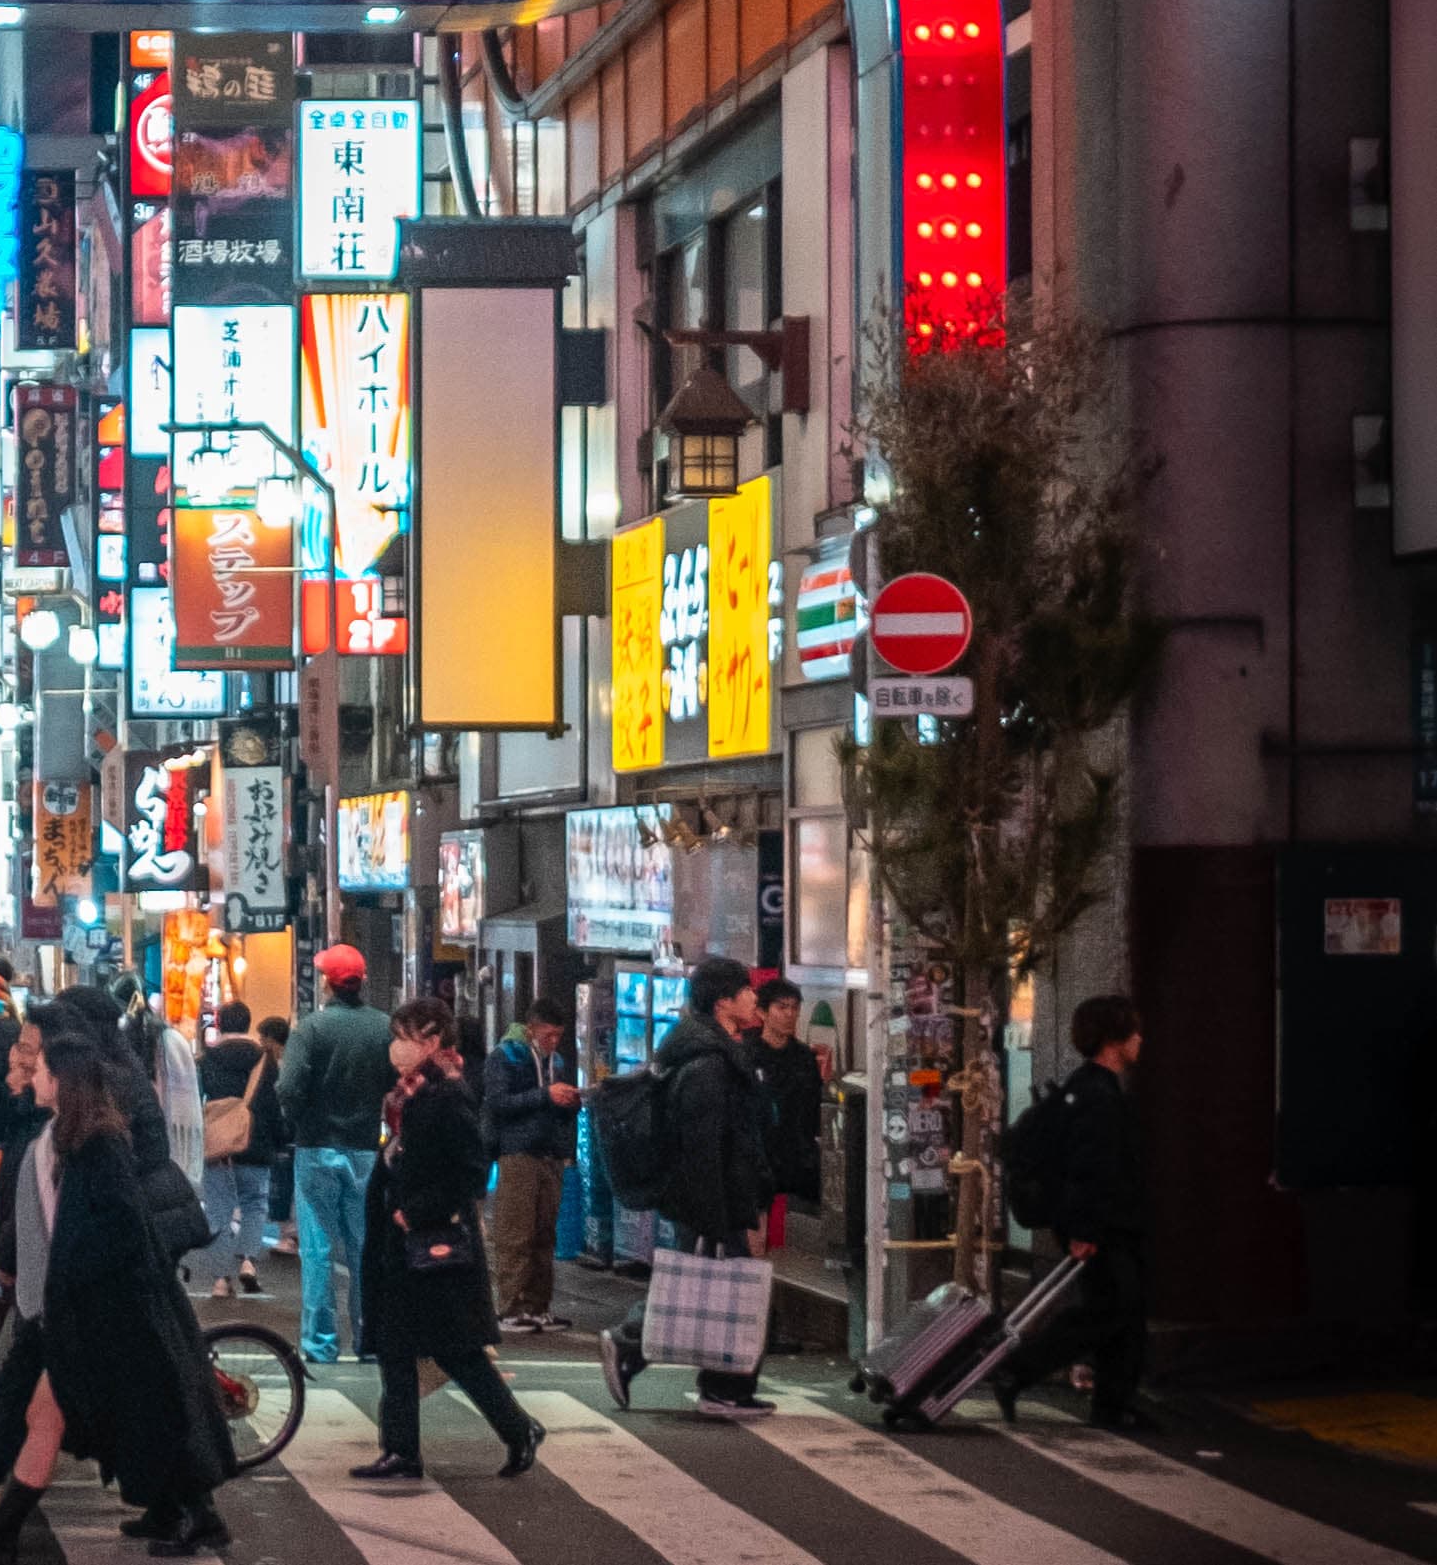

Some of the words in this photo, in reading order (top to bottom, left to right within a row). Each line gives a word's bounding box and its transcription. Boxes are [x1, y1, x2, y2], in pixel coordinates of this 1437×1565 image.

[178, 239, 282, 265] 酒場牧場
[331, 138, 366, 272] 東南荘
[221, 318, 242, 466] 芝浦ホル
[206, 512, 261, 642] ステップ
[875, 682, 965, 708] 自転車を除く
